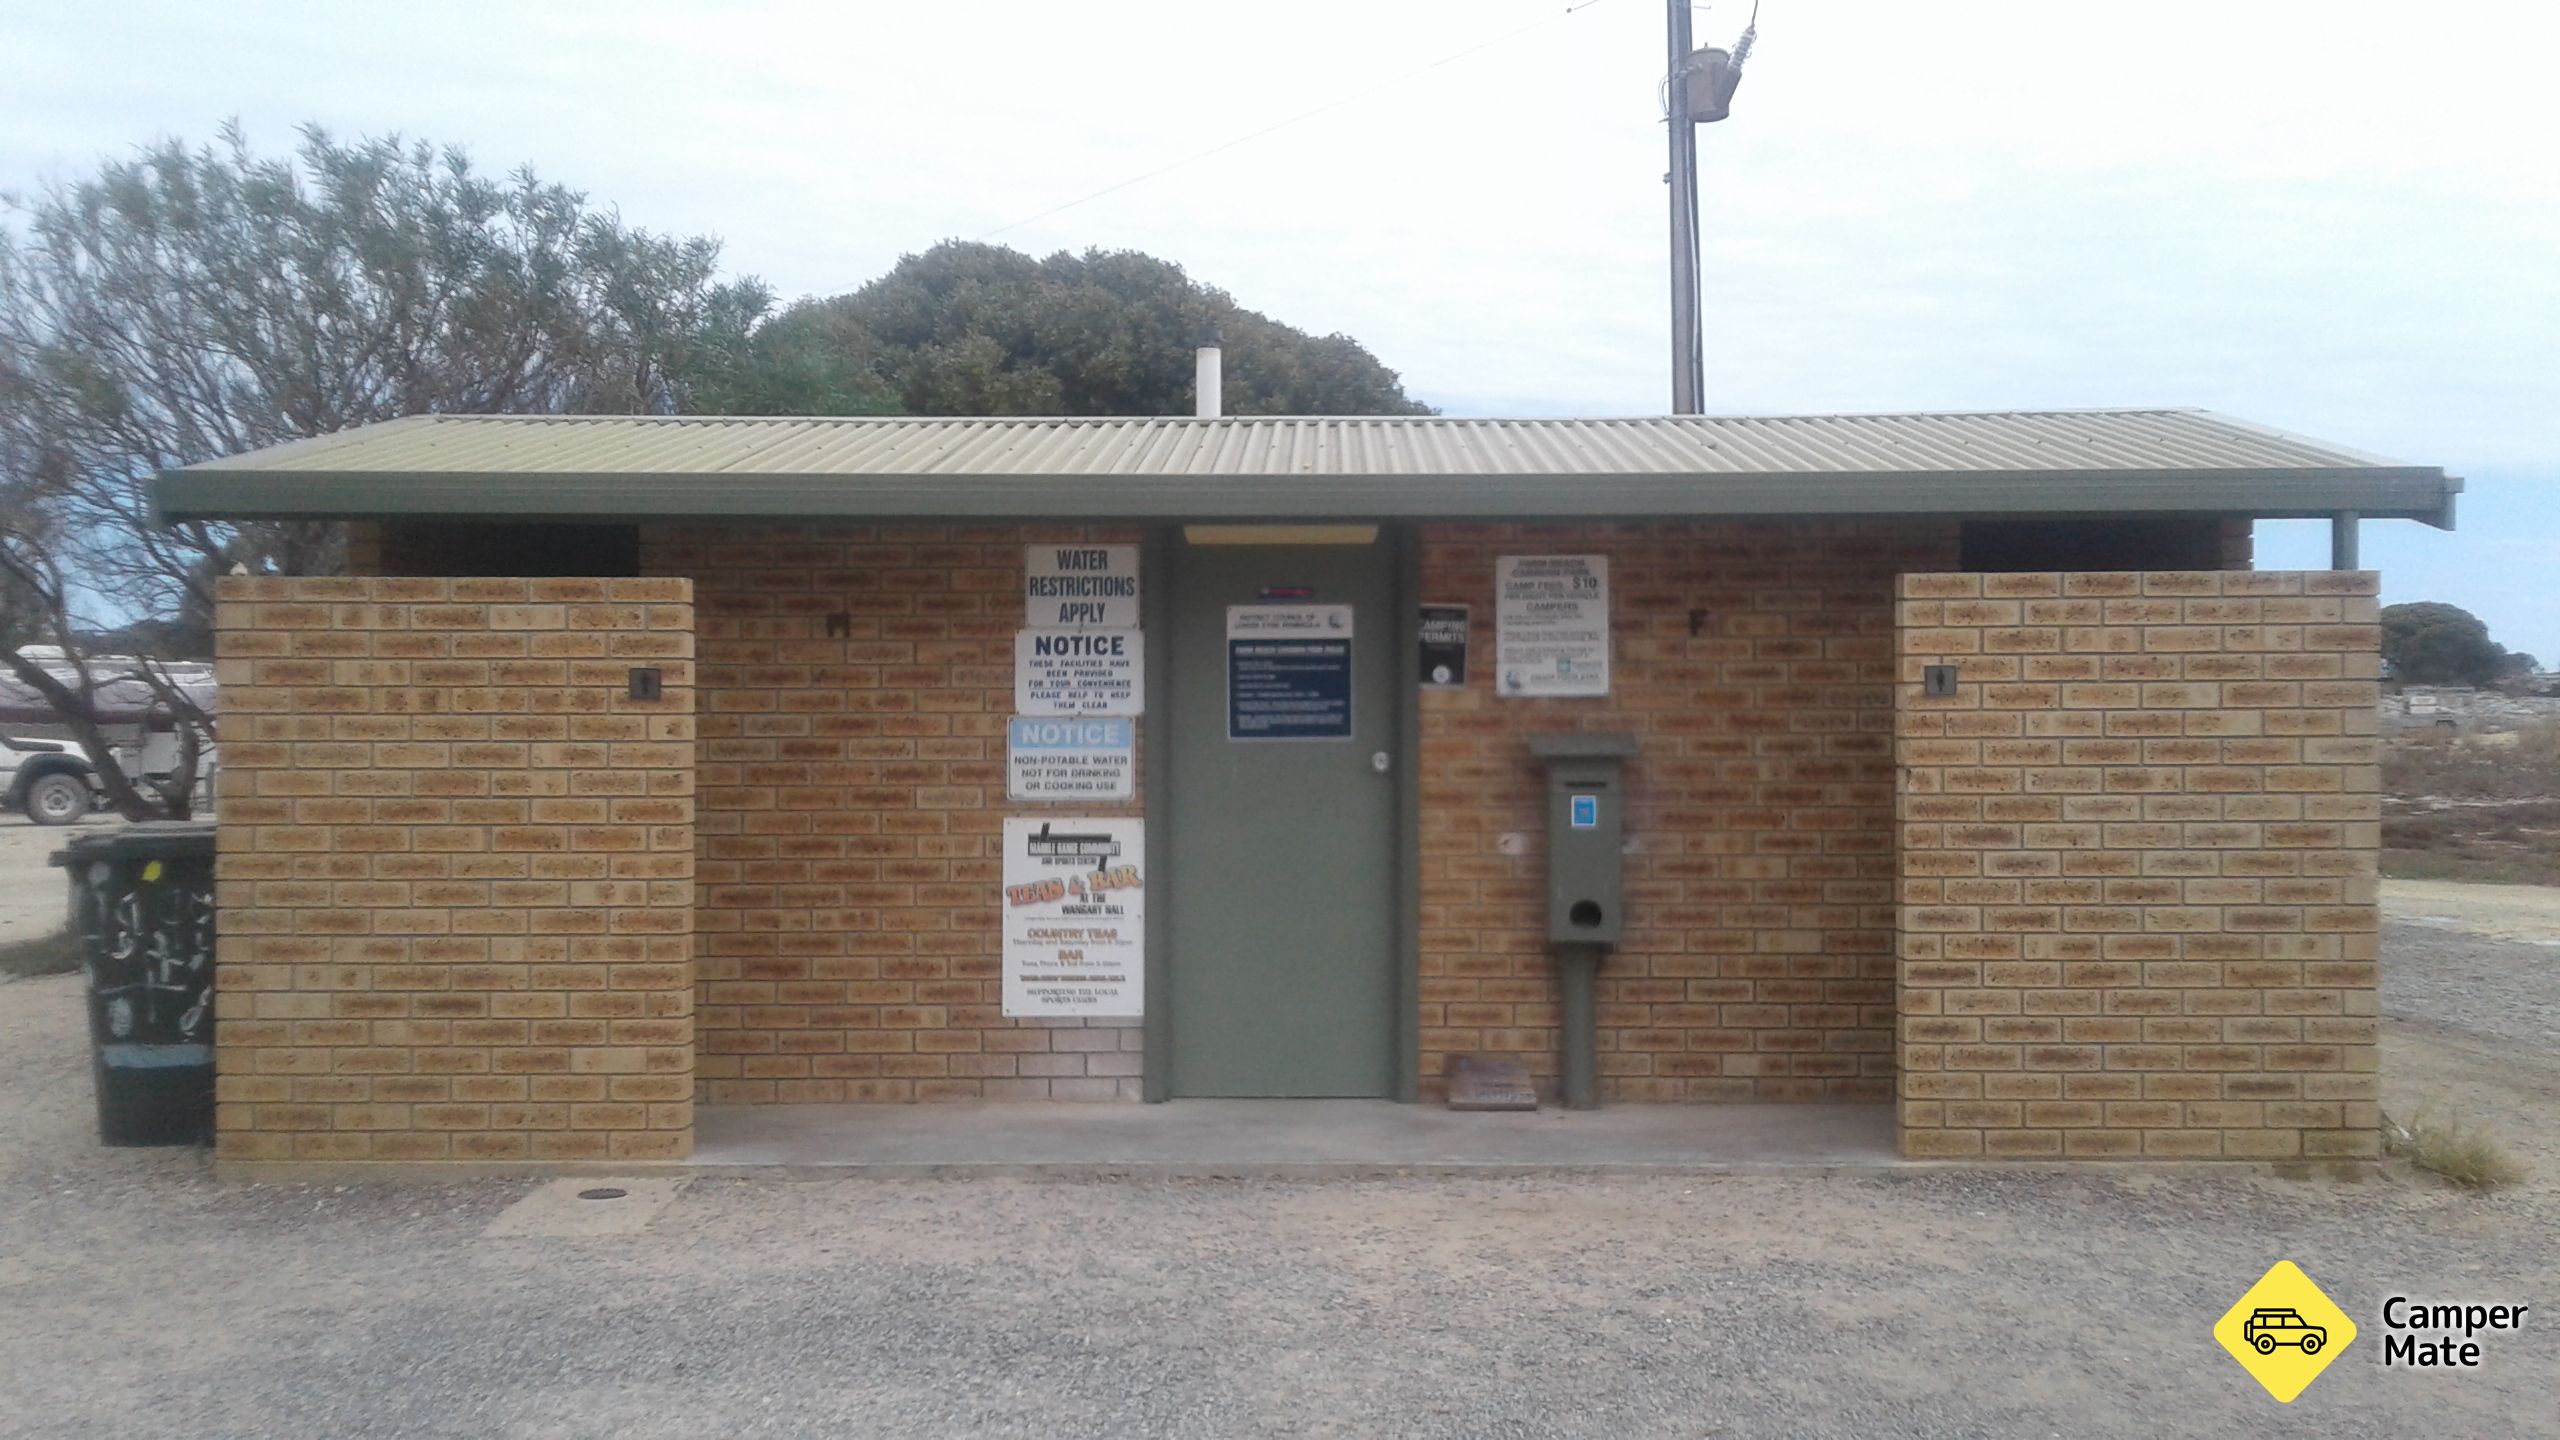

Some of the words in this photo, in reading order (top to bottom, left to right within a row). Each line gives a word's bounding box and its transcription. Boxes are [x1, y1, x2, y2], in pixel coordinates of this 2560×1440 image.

[1057, 549, 1108, 570] WATER
[1029, 576, 1136, 597] RESTRICTIONS
[1572, 576, 1598, 589] $10
[1058, 602, 1106, 623] APPLY
[1035, 635, 1125, 656] NOTICE
[1029, 660, 1053, 668] THESE
[1060, 660, 1103, 668] FACILITIES
[1109, 660, 1130, 668] HAVE
[1046, 670, 1067, 678] BEEN
[1073, 670, 1113, 678] PROVIDED
[1028, 680, 1043, 688] FOR
[1050, 680, 1071, 688] YOUR
[1077, 680, 1132, 688] CONVENIENCE
[1030, 691, 1061, 699] PLEASE
[1068, 691, 1088, 699] HELP
[1094, 691, 1104, 699] TO
[1110, 691, 1131, 699] KEEP
[1053, 701, 1076, 709] THEM
[1021, 724, 1120, 745] NOTICE
[1014, 755, 1089, 765] NON-POTABLE
[1092, 755, 1128, 765] WATER
[1021, 768, 1042, 778] NOT
[1046, 768, 1068, 778] FOR
[1071, 768, 1121, 778] DRINKING
[1025, 781, 1041, 791] OR
[1044, 781, 1093, 791] COOKING
[1096, 781, 1117, 791] USE
[1087, 864, 1143, 891] BAR
[1092, 893, 1106, 903] THE
[1058, 949, 1084, 960] BAR
